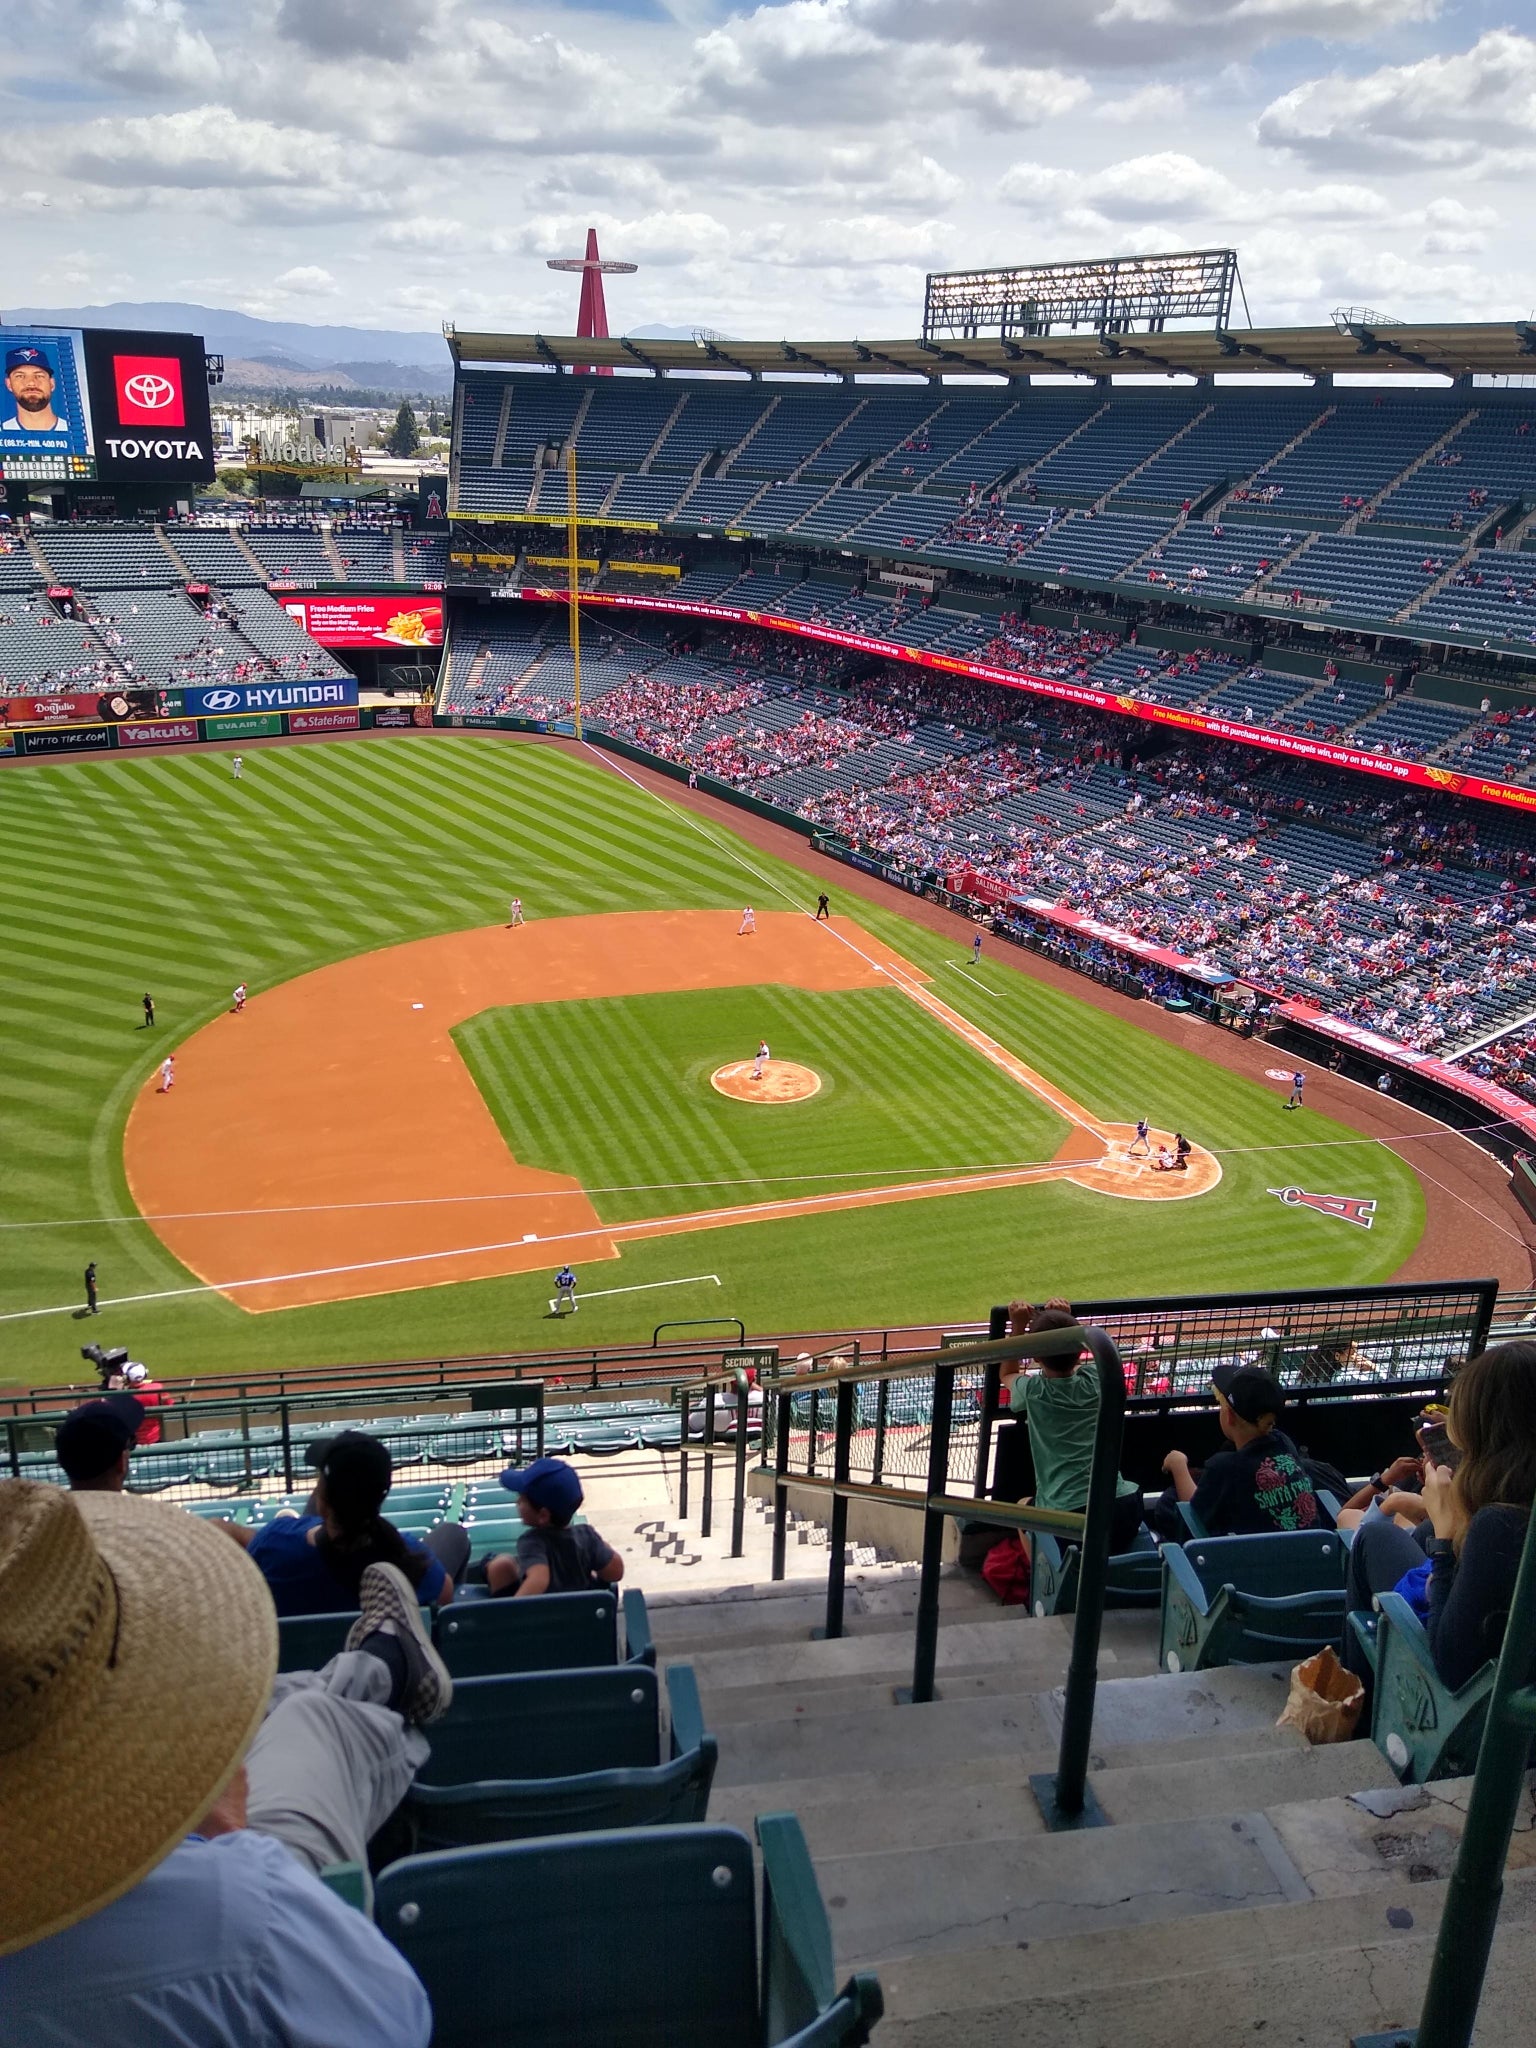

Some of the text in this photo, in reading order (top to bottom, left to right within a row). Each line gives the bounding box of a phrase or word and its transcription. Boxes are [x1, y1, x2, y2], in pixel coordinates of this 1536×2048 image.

[105, 440, 203, 459] TOYOTA
[259, 431, 346, 463] Modelo
[941, 659, 958, 668] Medium
[958, 663, 968, 671] Fries
[985, 670, 1005, 680] purchase
[1006, 675, 1018, 684] when
[1028, 680, 1044, 689] Angels
[1045, 684, 1054, 693] win,
[1055, 687, 1066, 696] only
[1074, 690, 1082, 698] the
[1083, 692, 1095, 700] McD
[1095, 696, 1106, 705] app
[246, 685, 344, 706] HYUNDAI
[28, 732, 106, 746] NITTO TIRE.COM
[124, 725, 192, 739] Yakult
[1153, 709, 1408, 776] Free Medium Fries with $2 purchase when the Angels win, only on the McD app
[1482, 785, 1536, 805] Free Medium
[976, 877, 1004, 896] SALINAS,
[725, 1356, 772, 1367] SECTION 411
[1254, 1484, 1292, 1508] SANTA
